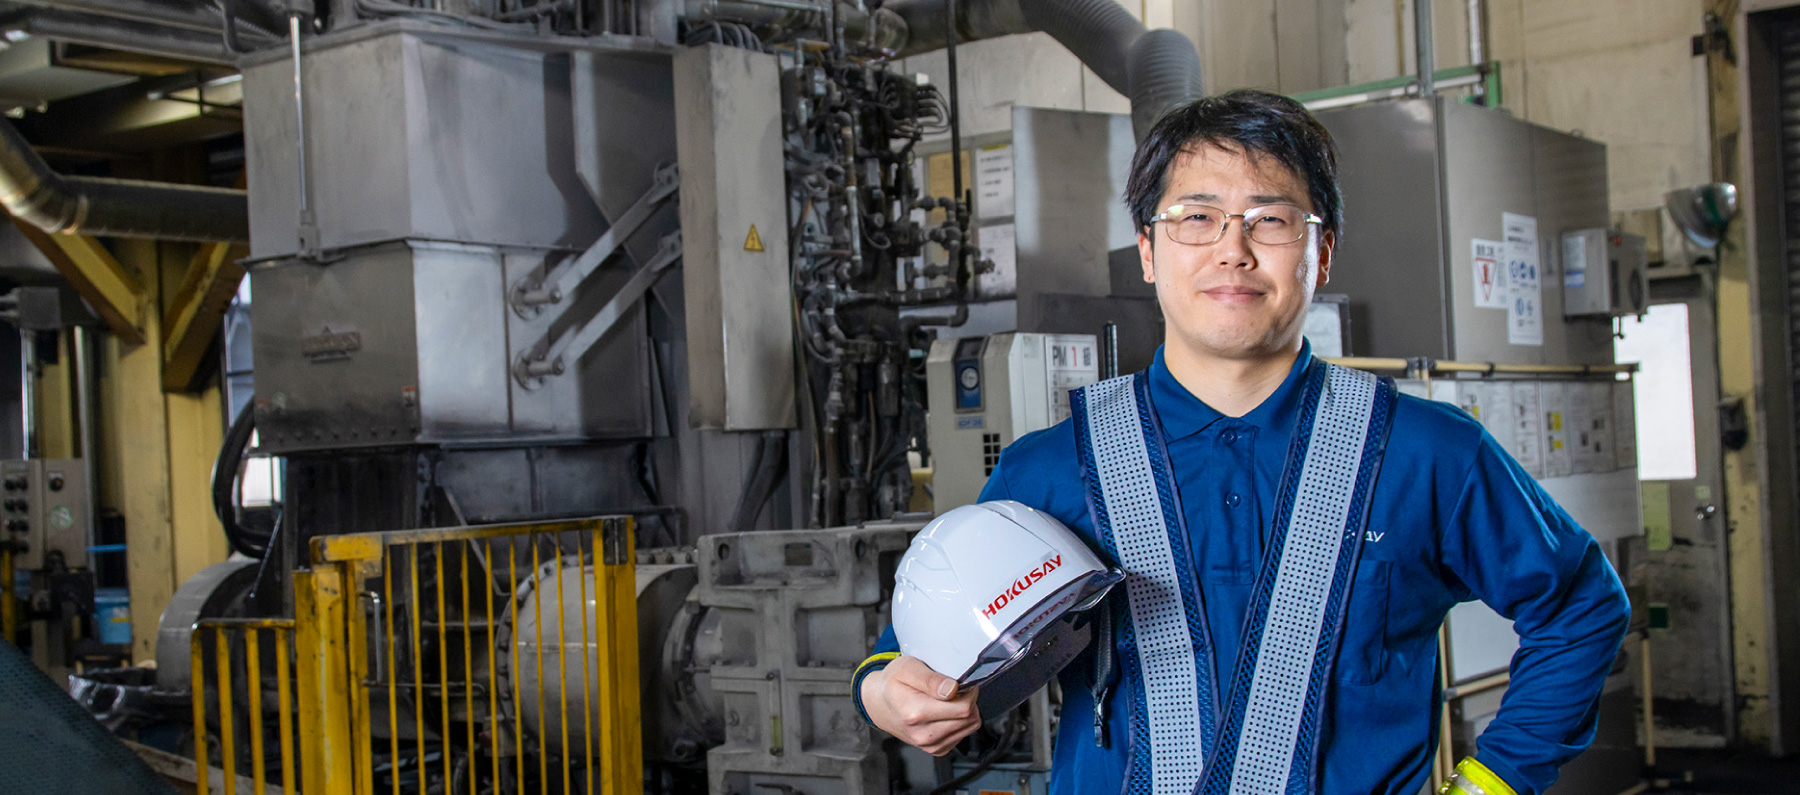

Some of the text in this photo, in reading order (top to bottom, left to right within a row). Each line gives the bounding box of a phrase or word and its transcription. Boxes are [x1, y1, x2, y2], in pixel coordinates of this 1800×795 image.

[1052, 345, 1068, 367] PM
[1071, 345, 1077, 367] 1
[981, 554, 1062, 620] HOKUSAY
